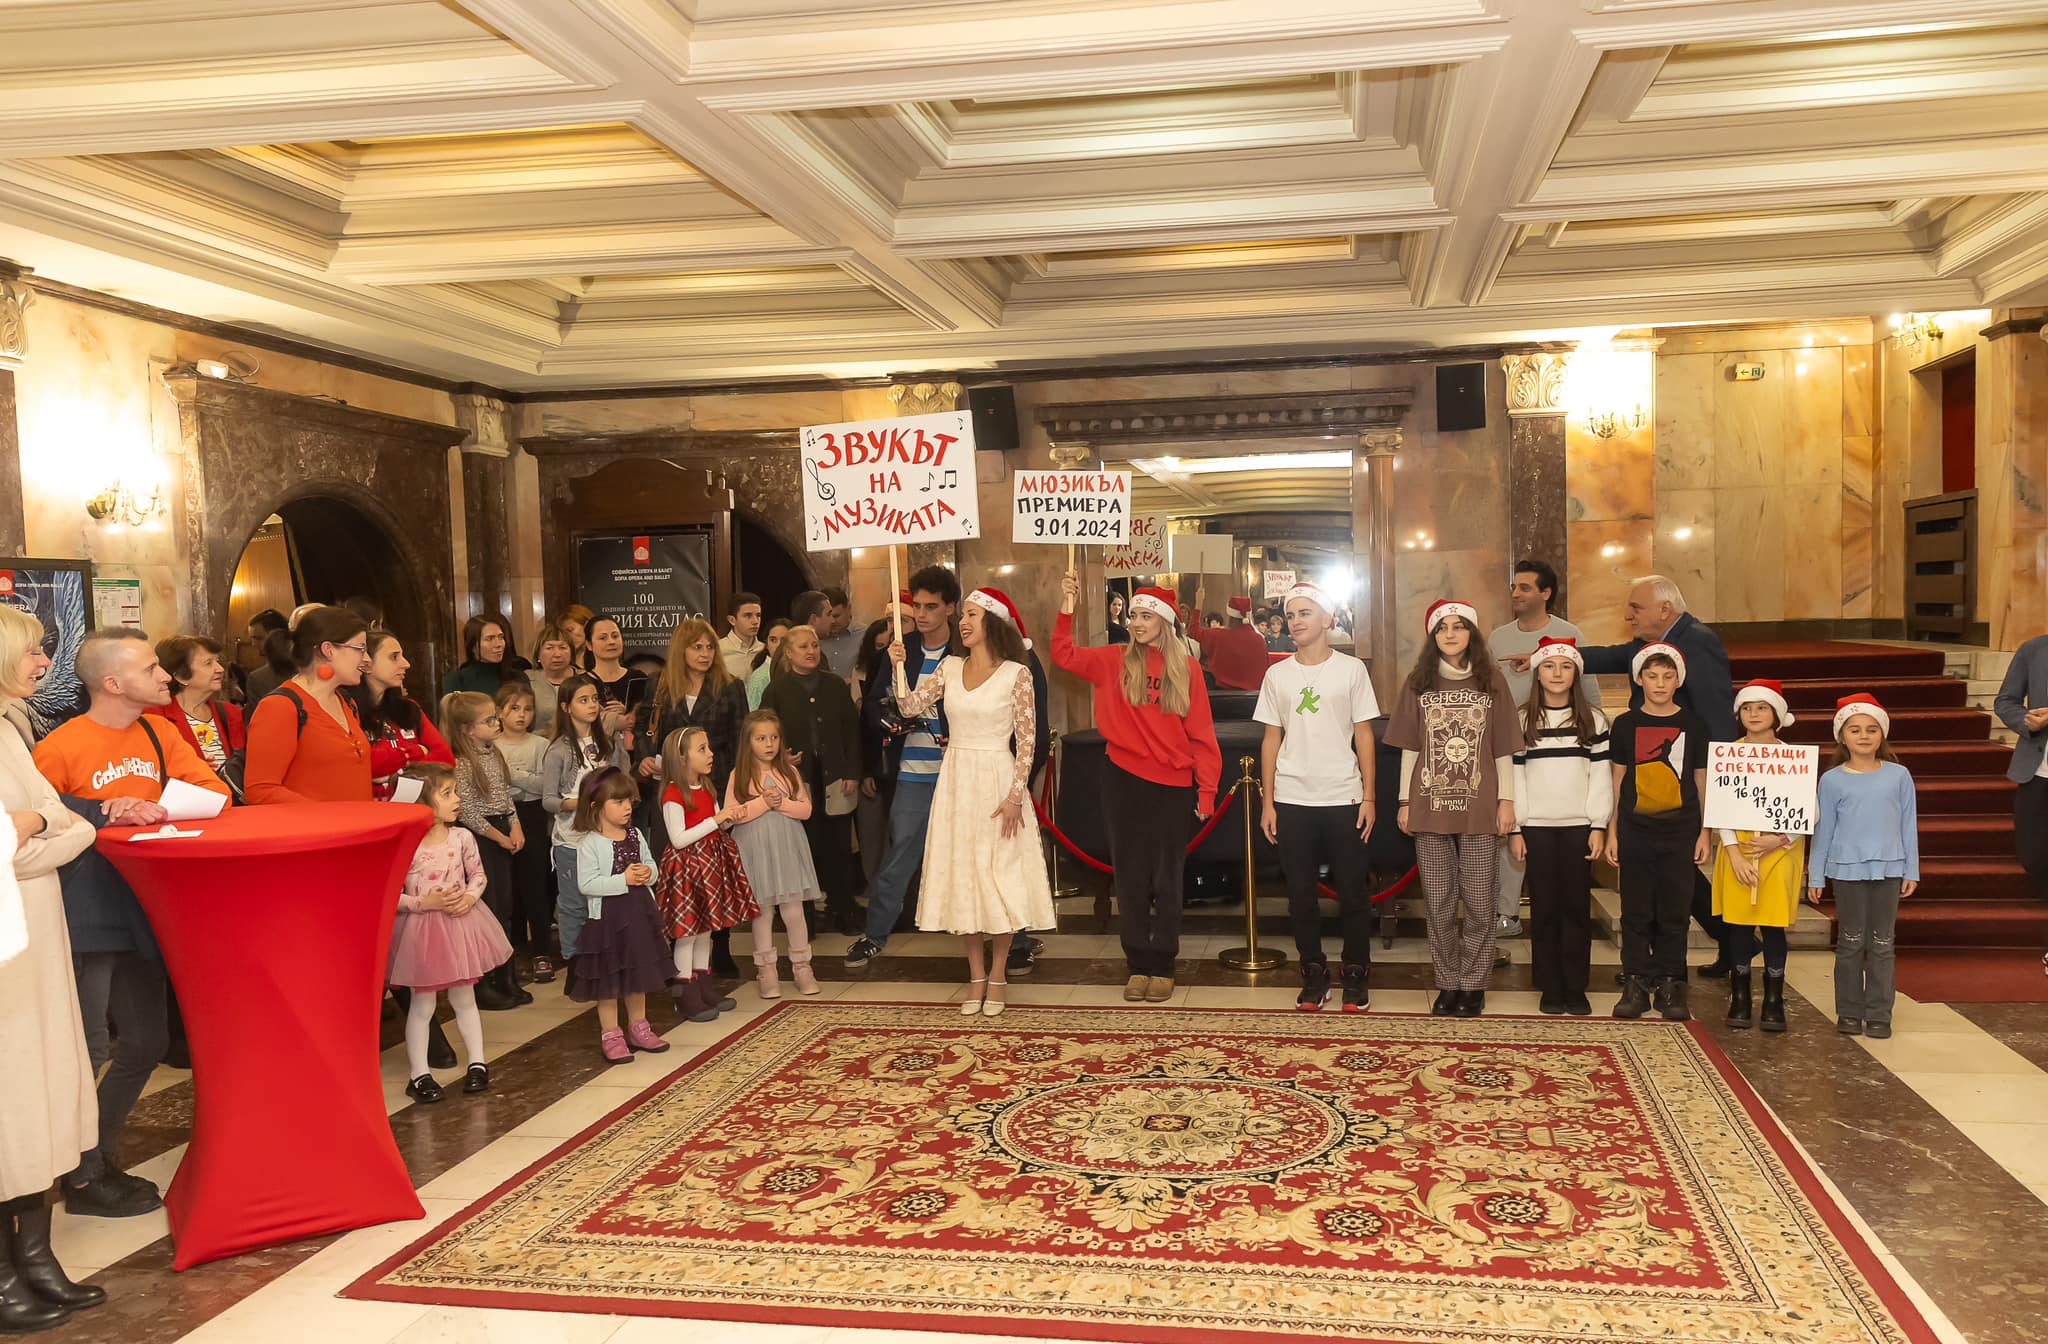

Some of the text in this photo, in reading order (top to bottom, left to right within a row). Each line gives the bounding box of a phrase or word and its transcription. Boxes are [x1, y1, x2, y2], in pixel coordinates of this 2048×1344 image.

[817, 427, 959, 469] ЗВУКЪТ
[869, 470, 902, 494] НА
[1019, 474, 1125, 493] МЮЗИКЪЛ
[1017, 497, 1122, 514] ПРЕМИЕРА
[823, 497, 956, 542] МУЗИКАТА
[1034, 518, 1121, 538] 9.01.2024
[633, 593, 654, 605] 100
[1715, 745, 1806, 760] СЛЕДВАЩИ
[1715, 762, 1809, 775] СПЕКТАКЛИ
[1714, 775, 1748, 787] 10.01
[1734, 787, 1766, 799] 16.01
[1753, 797, 1789, 808] 17.01
[1765, 807, 1804, 819] 30.01
[1773, 819, 1809, 831] 31.01
